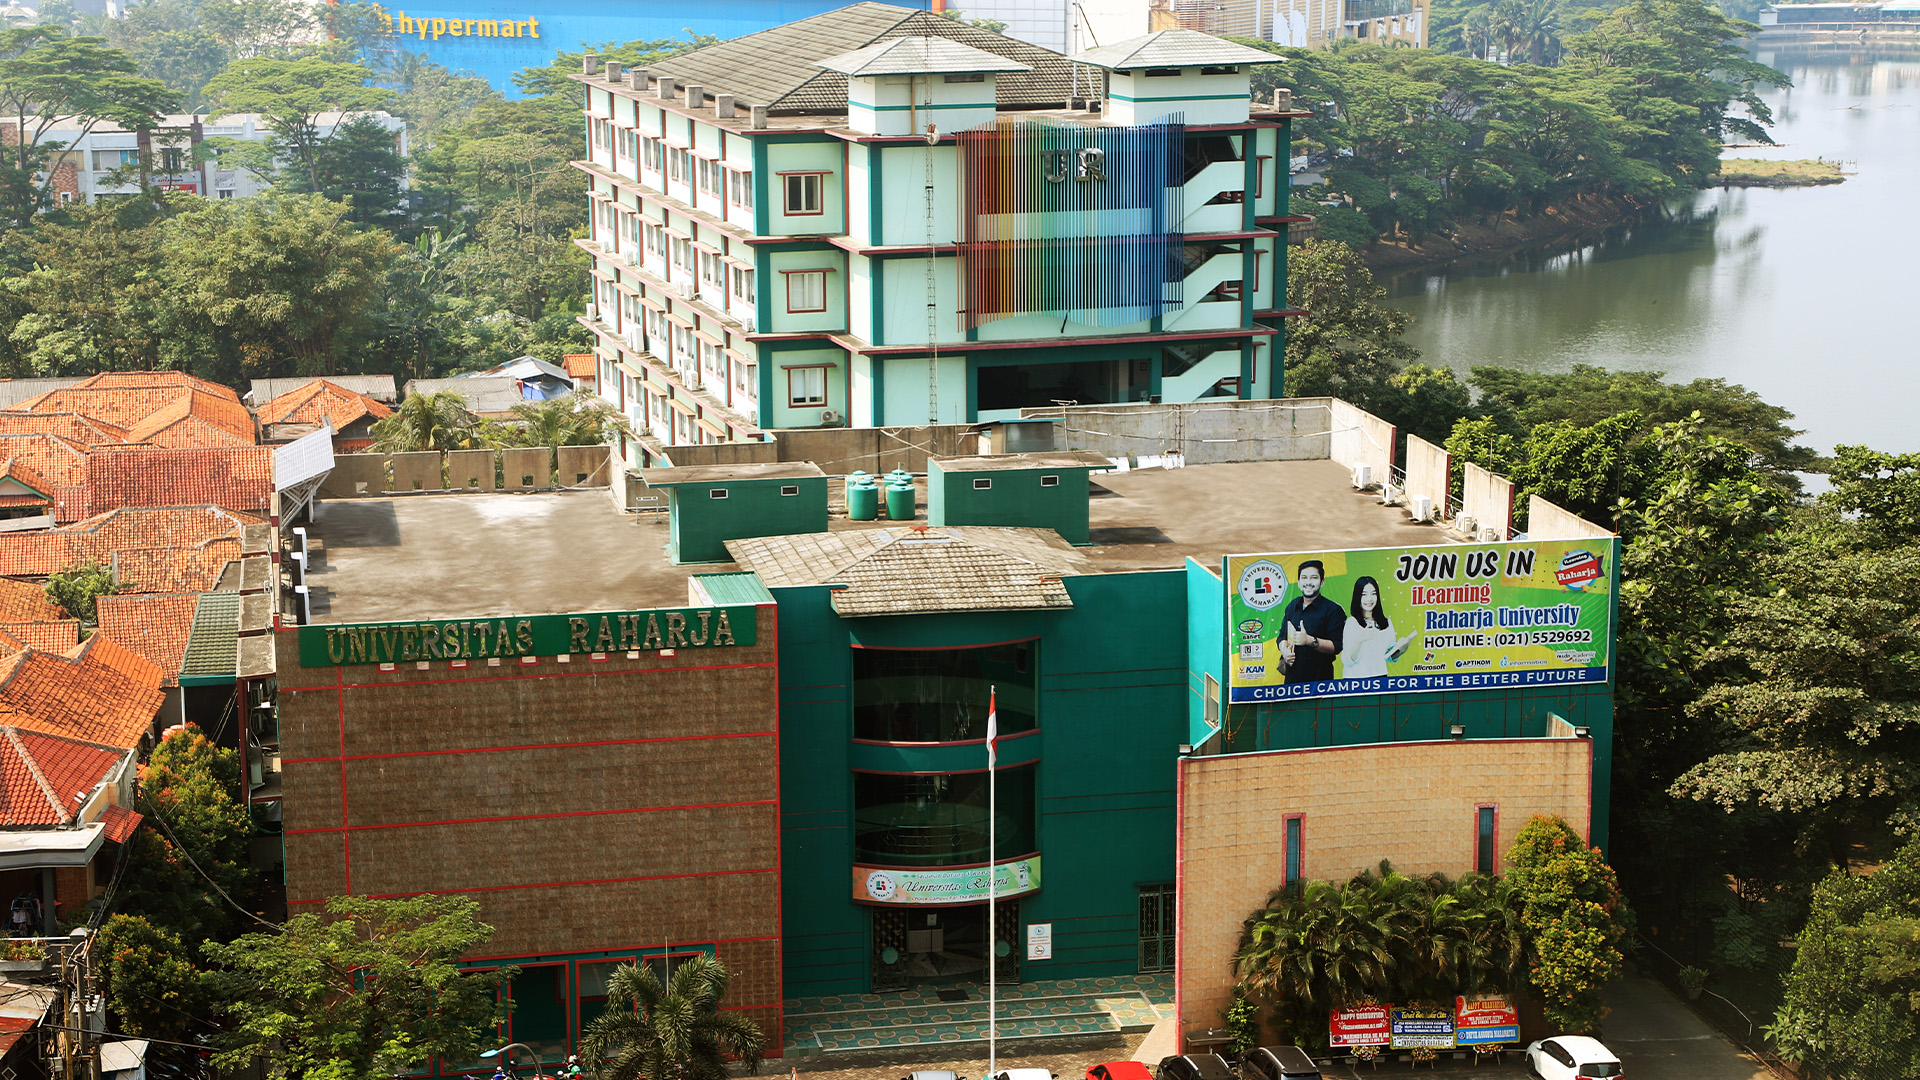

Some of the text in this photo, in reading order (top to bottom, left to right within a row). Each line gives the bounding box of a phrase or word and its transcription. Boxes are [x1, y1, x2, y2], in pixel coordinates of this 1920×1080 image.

[399, 10, 540, 40] hypermart
[1040, 148, 1107, 182] UR
[1244, 566, 1282, 582] UNIVERSITAS
[1396, 550, 1535, 580] JOIN US IN
[1557, 567, 1597, 582] Raharja
[1249, 594, 1279, 606] RAHARJA
[1412, 583, 1491, 605] iLearning
[1425, 604, 1580, 630] Raharja University
[325, 610, 736, 663] UNIVERSITAS RAHARJA
[1424, 634, 1484, 648] HOTLINE
[1494, 632, 1529, 647] (021)
[1532, 630, 1591, 644] 5529692
[1245, 665, 1265, 673] KAN
[1413, 663, 1446, 671] Microsoft
[1253, 670, 1586, 699] CHOICE CAMPUS FOR THE BETTER FUTURE
[902, 881, 963, 892] Universitas
